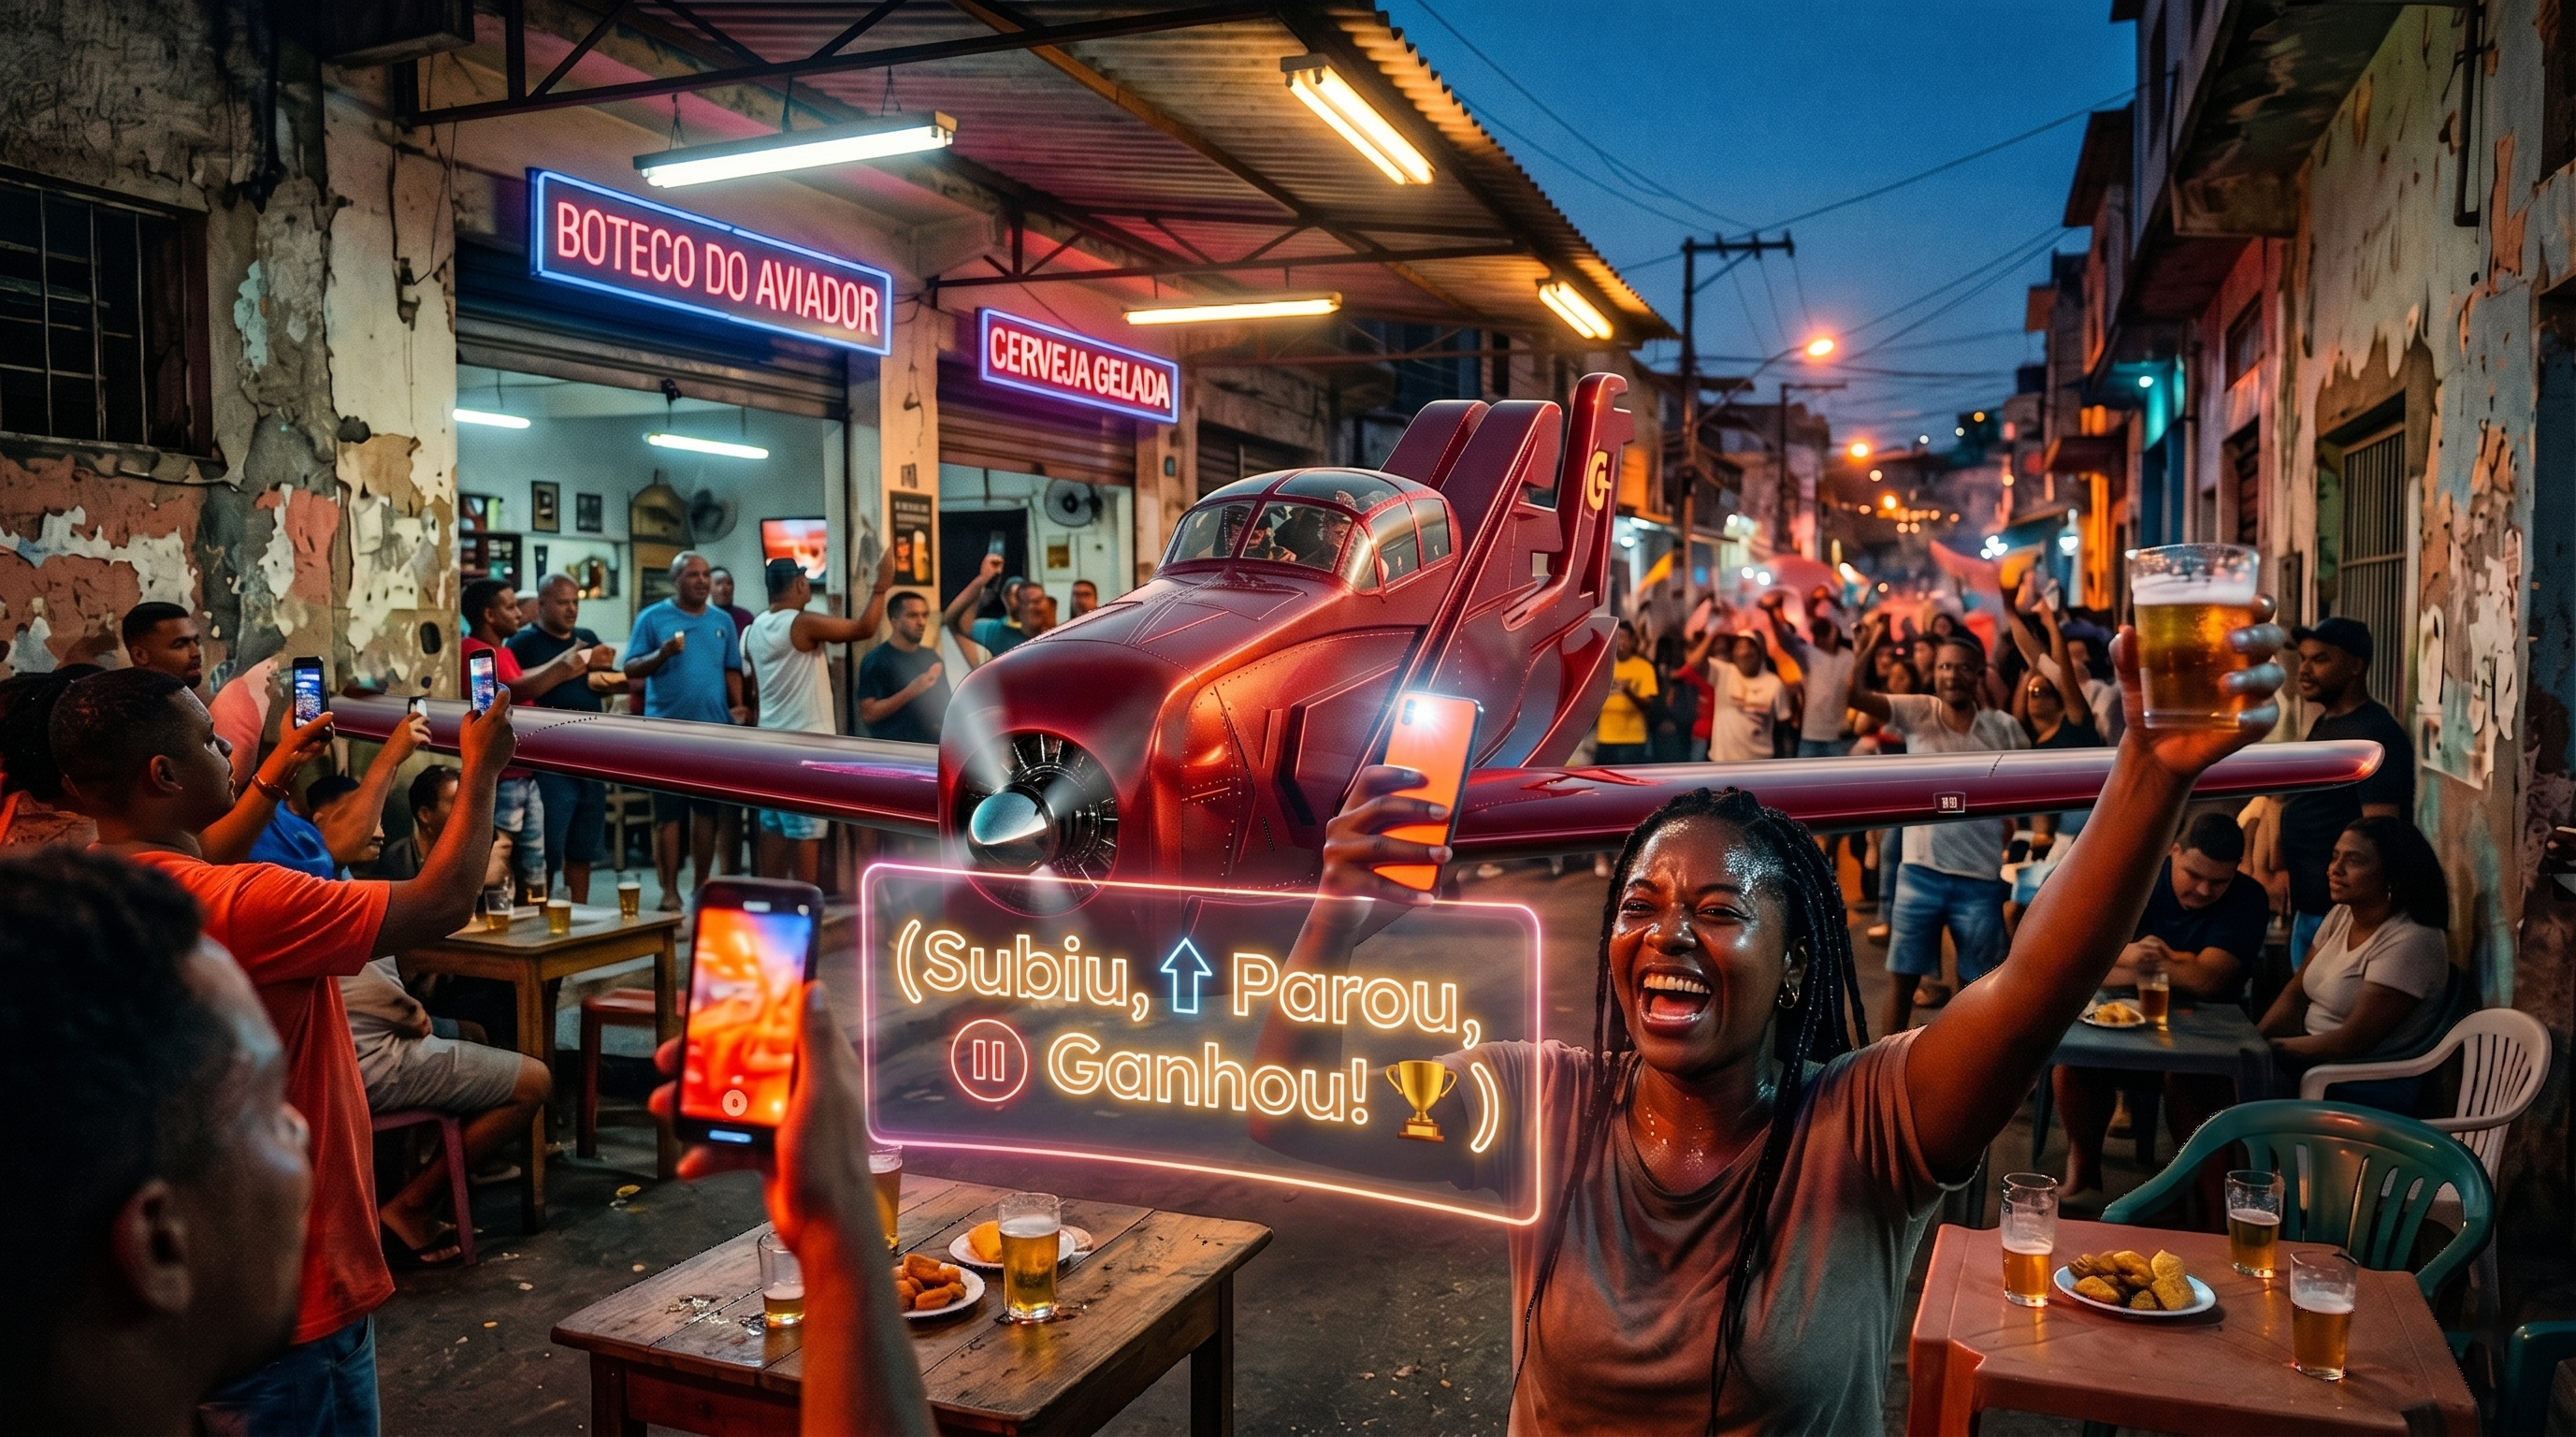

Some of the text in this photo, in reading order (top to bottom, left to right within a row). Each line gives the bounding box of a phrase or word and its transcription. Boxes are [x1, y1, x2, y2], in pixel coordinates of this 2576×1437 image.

[557, 202, 879, 336] BOTECO DO AVIADOR
[990, 327, 1171, 409] CERVEJA GELADA
[1586, 450, 1612, 511] G
[896, 919, 1481, 1050] (Subiu, Parou,
[1048, 1032, 1368, 1125] Ganhou!
